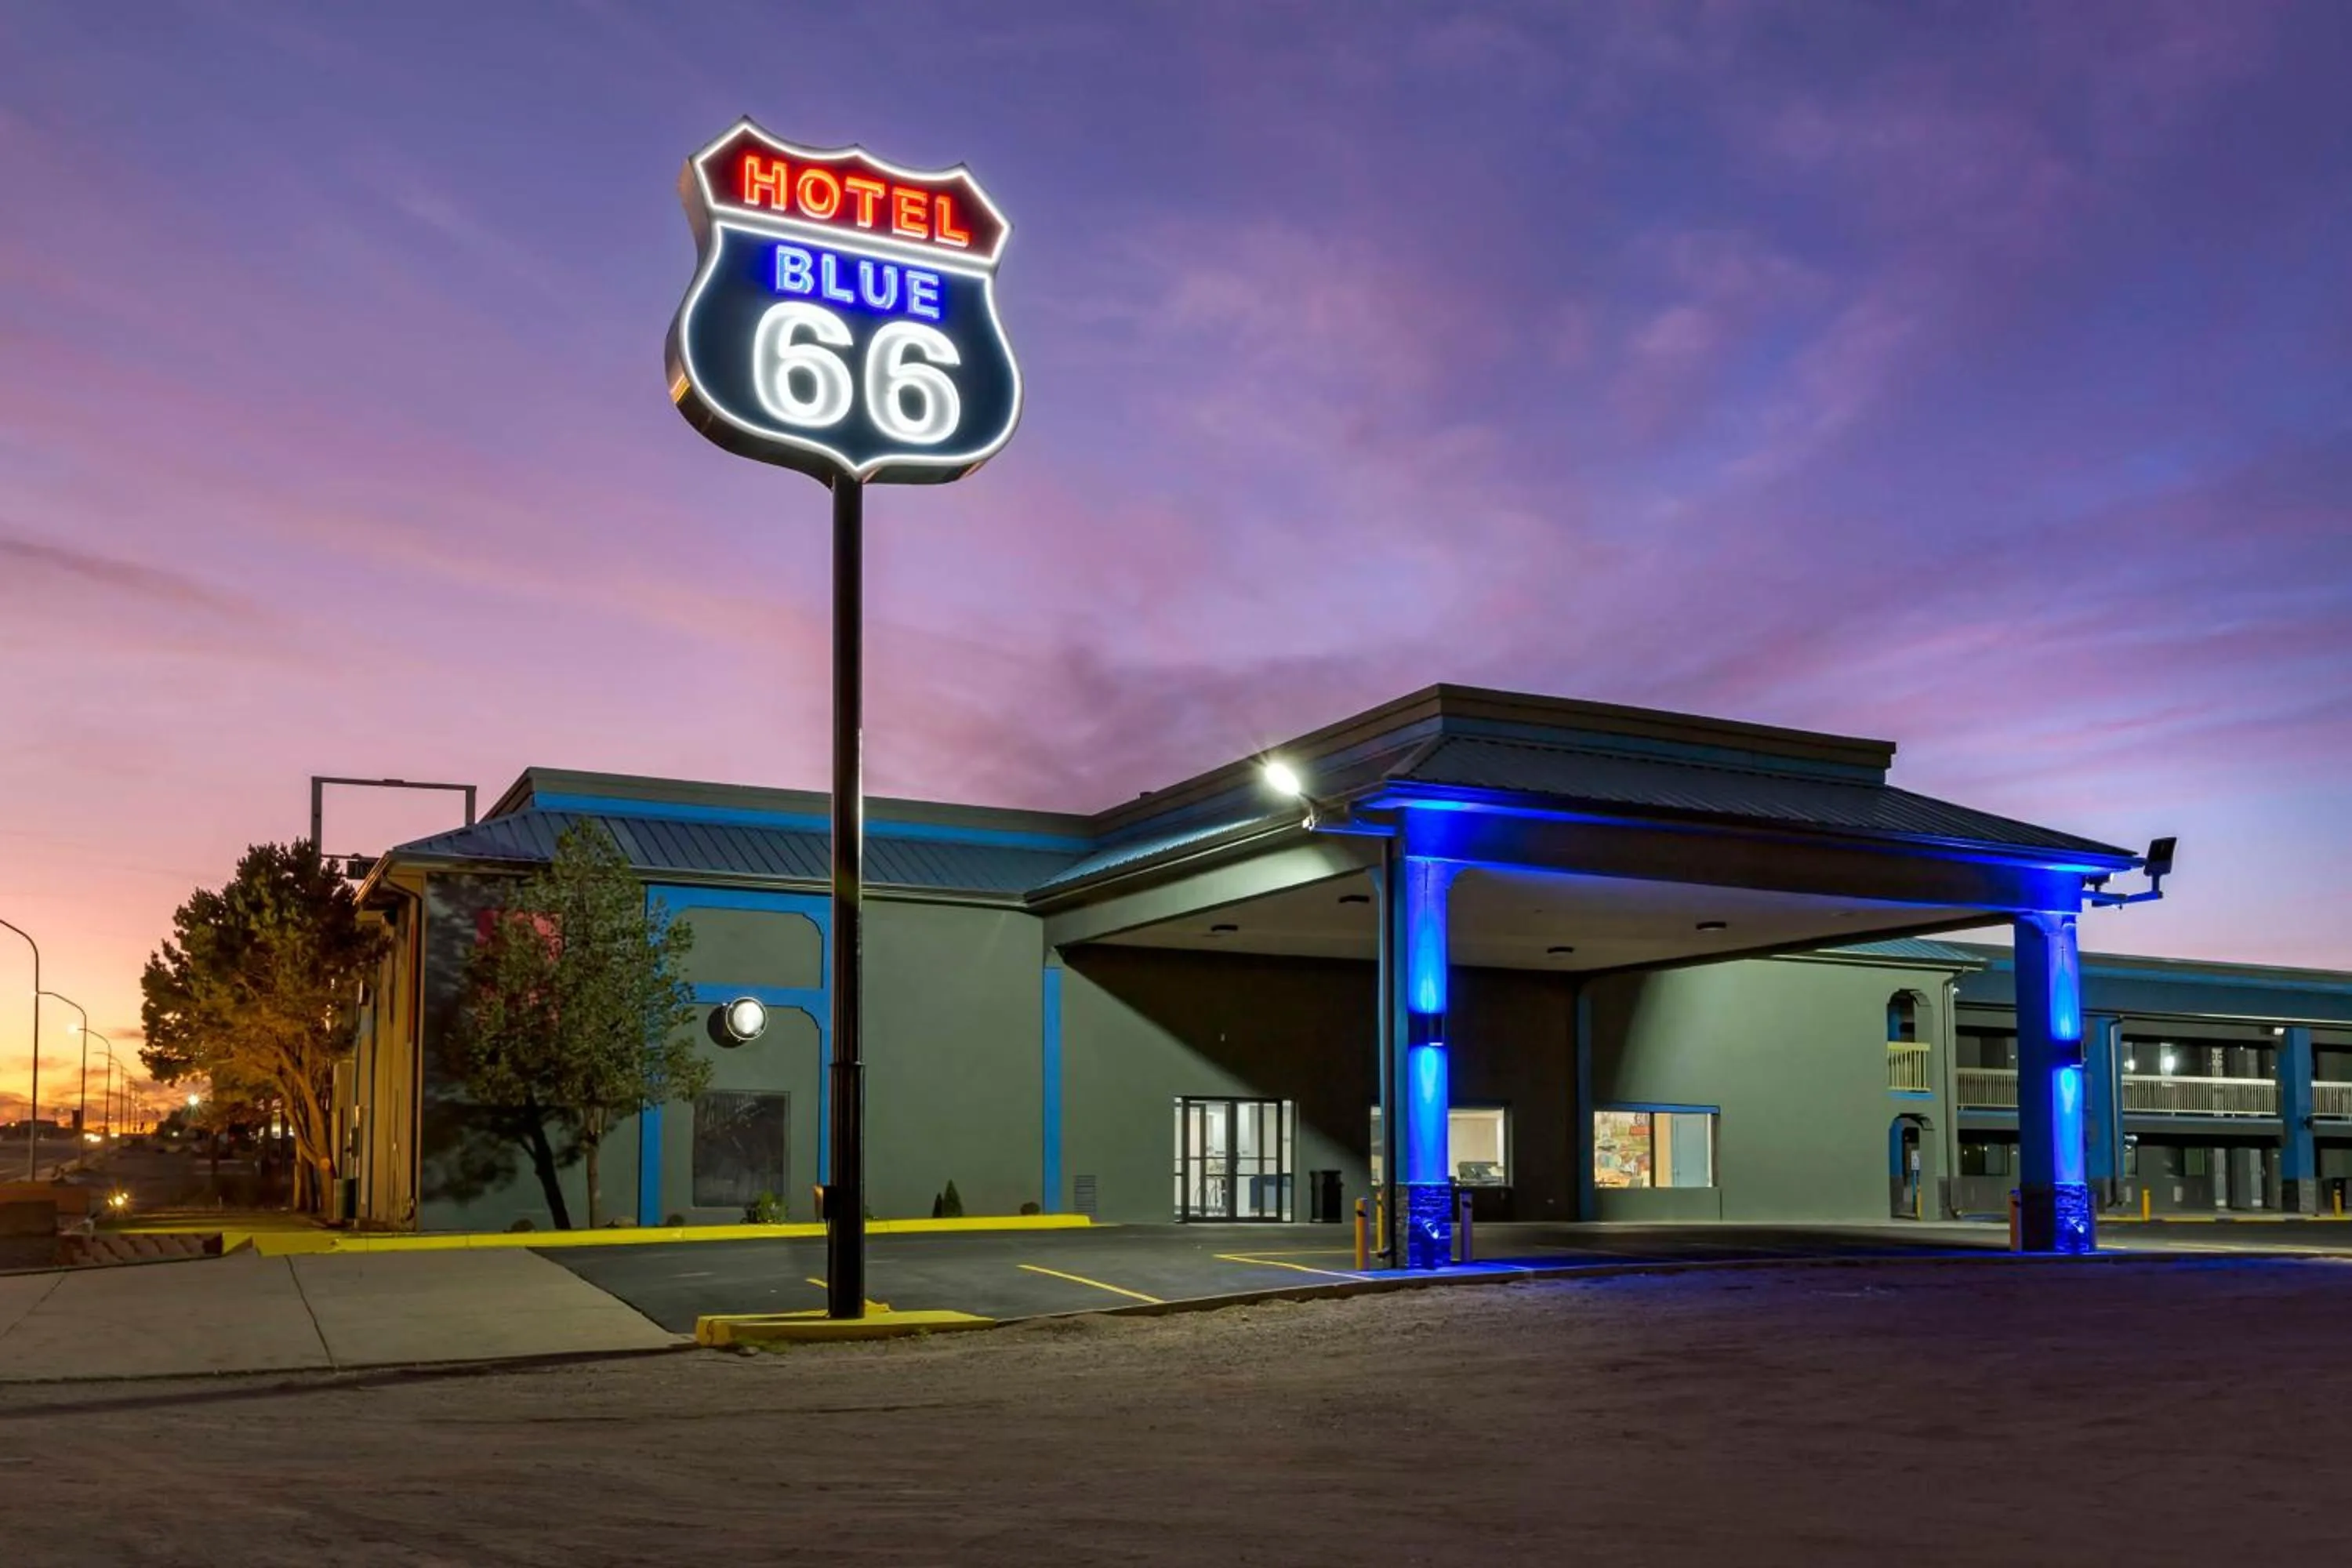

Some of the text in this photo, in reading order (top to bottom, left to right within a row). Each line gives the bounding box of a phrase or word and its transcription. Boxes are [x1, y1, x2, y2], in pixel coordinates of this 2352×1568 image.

[743, 155, 969, 247] HOTEL
[775, 245, 940, 318] BLUE
[753, 301, 961, 445] 66
